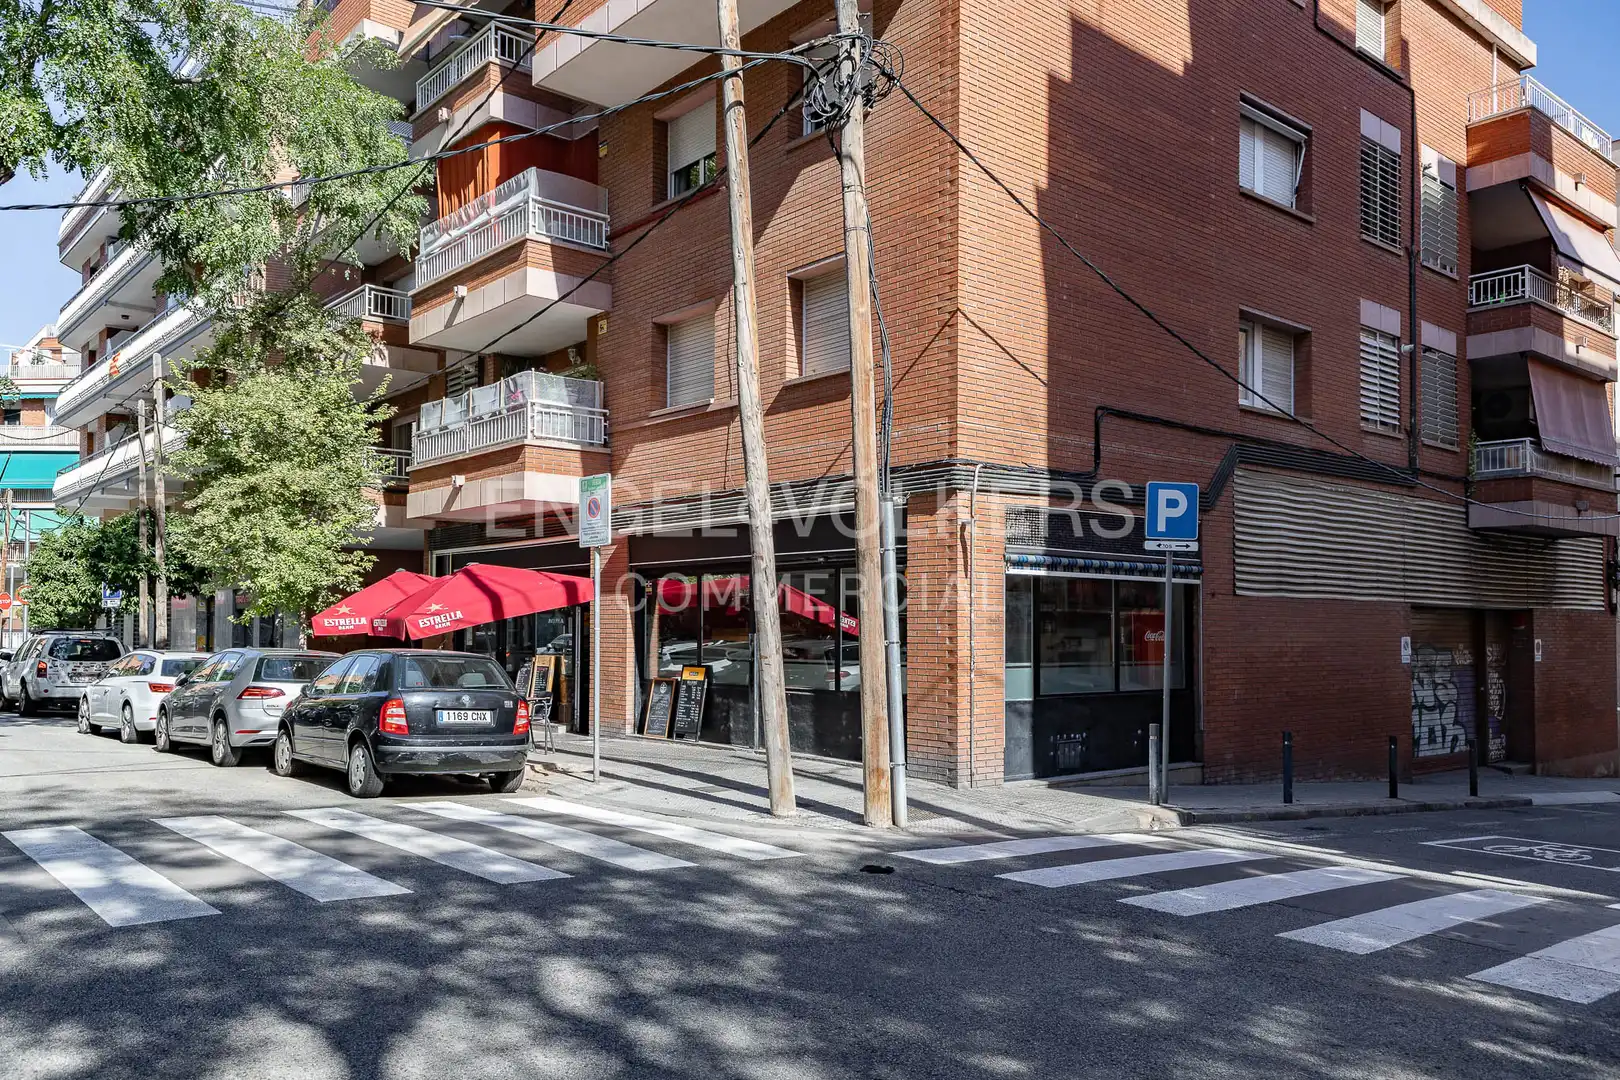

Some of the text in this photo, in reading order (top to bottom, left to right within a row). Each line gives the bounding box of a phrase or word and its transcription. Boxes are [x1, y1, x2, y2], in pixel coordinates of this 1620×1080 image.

[1157, 489, 1188, 531] P
[324, 617, 367, 626] ESTRELLA
[418, 610, 464, 628] ESTRELLA
[446, 711, 487, 721] 1169 CNX
